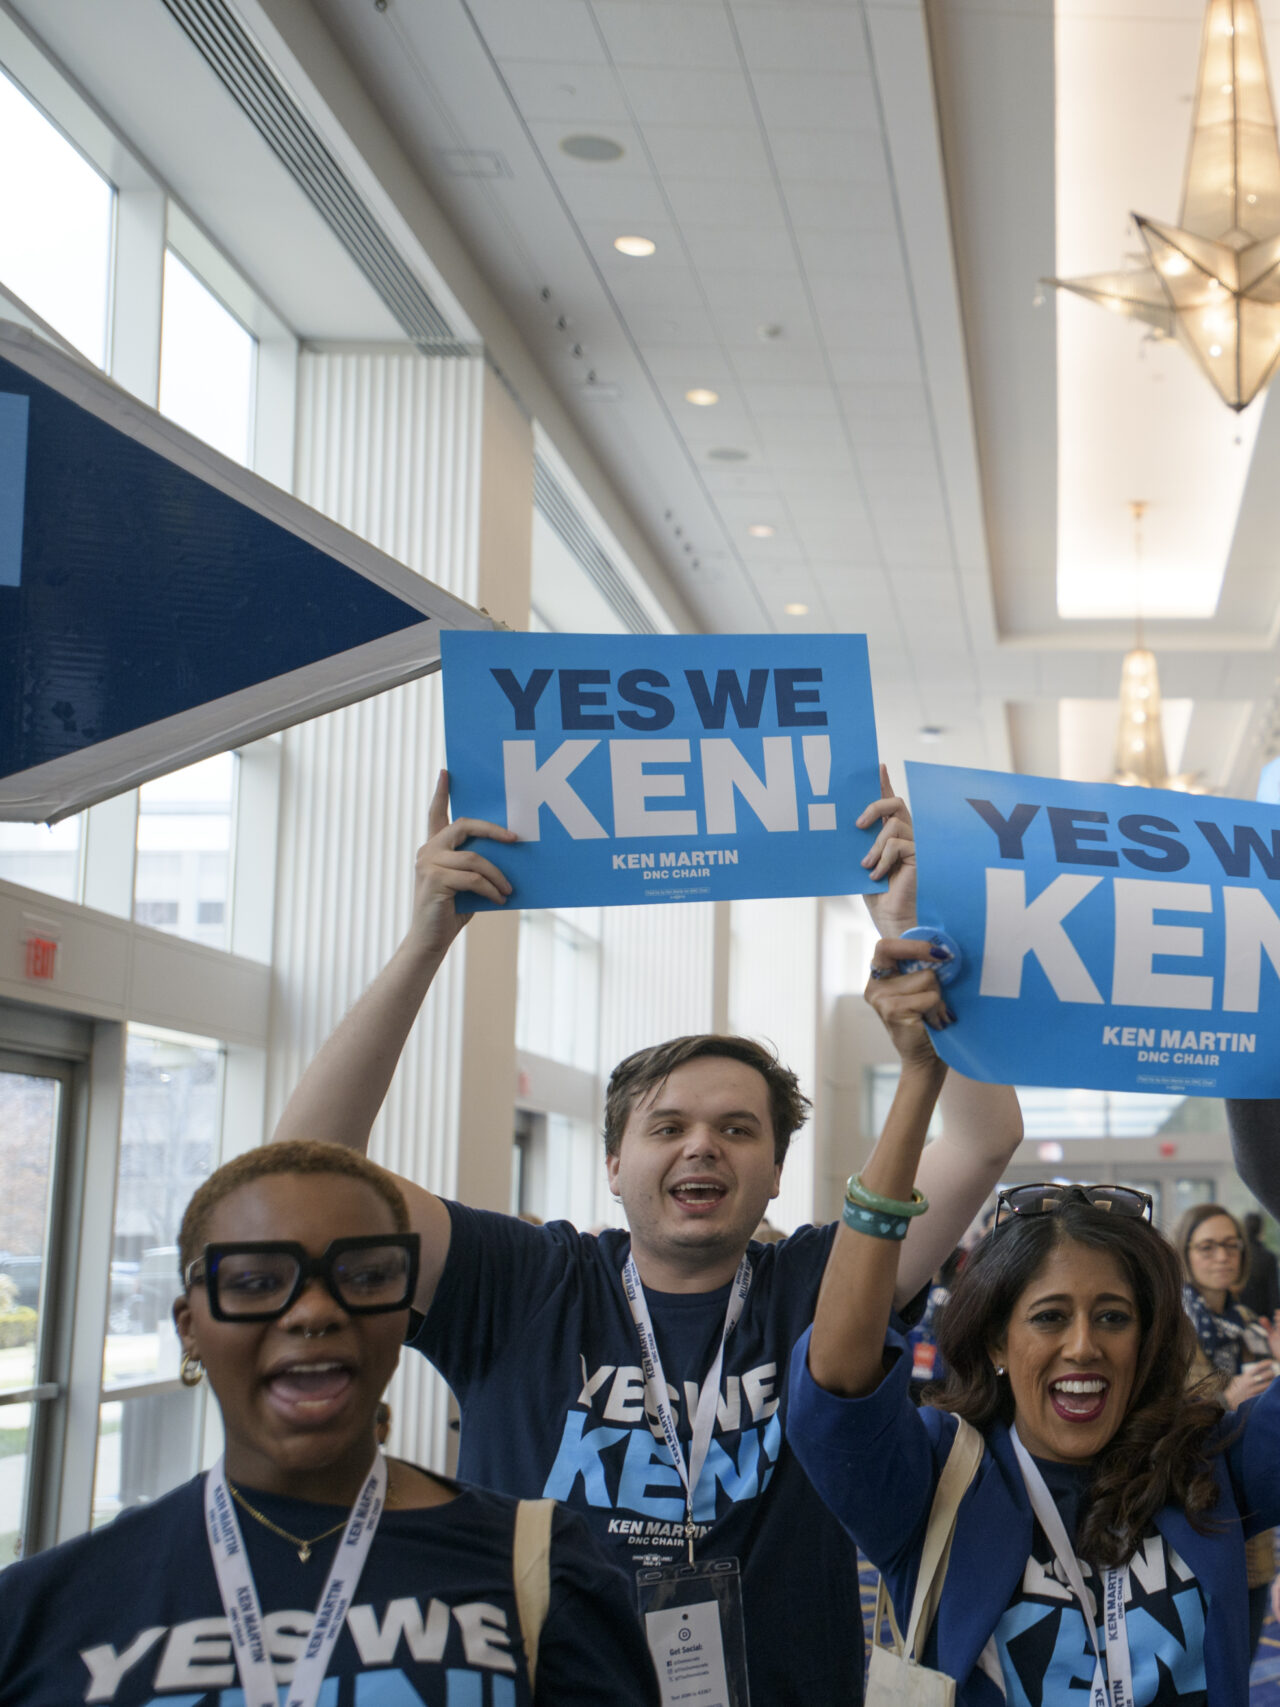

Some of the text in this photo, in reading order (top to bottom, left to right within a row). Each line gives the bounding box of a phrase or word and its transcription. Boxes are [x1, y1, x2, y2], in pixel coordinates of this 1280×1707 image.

[489, 668, 828, 731] YES WE
[502, 735, 837, 842] KEN!
[612, 849, 739, 870] KEN MARTIN
[965, 798, 1190, 873] YES
[643, 868, 710, 880] DNC CHAIR
[1102, 1026, 1257, 1053] KEN MARTIN
[1137, 1050, 1220, 1067] DNC CHAIR
[626, 1283, 636, 1301] KEN
[635, 1321, 656, 1379] KEN MARTIN
[577, 1353, 780, 1438] YES WE
[655, 1402, 681, 1465] KEN MARTIN
[213, 1483, 240, 1556] KEN MARTIN
[345, 1518, 364, 1547] KEN
[608, 1519, 643, 1535] KEN
[628, 1536, 685, 1547] DNC CHAIR
[236, 1584, 265, 1663] KEN MARTIN
[305, 1577, 344, 1658] KEN MARTIN
[1106, 1570, 1118, 1640] KEN MARTI
[79, 1609, 320, 1702] YES
[347, 1597, 516, 1673] WE
